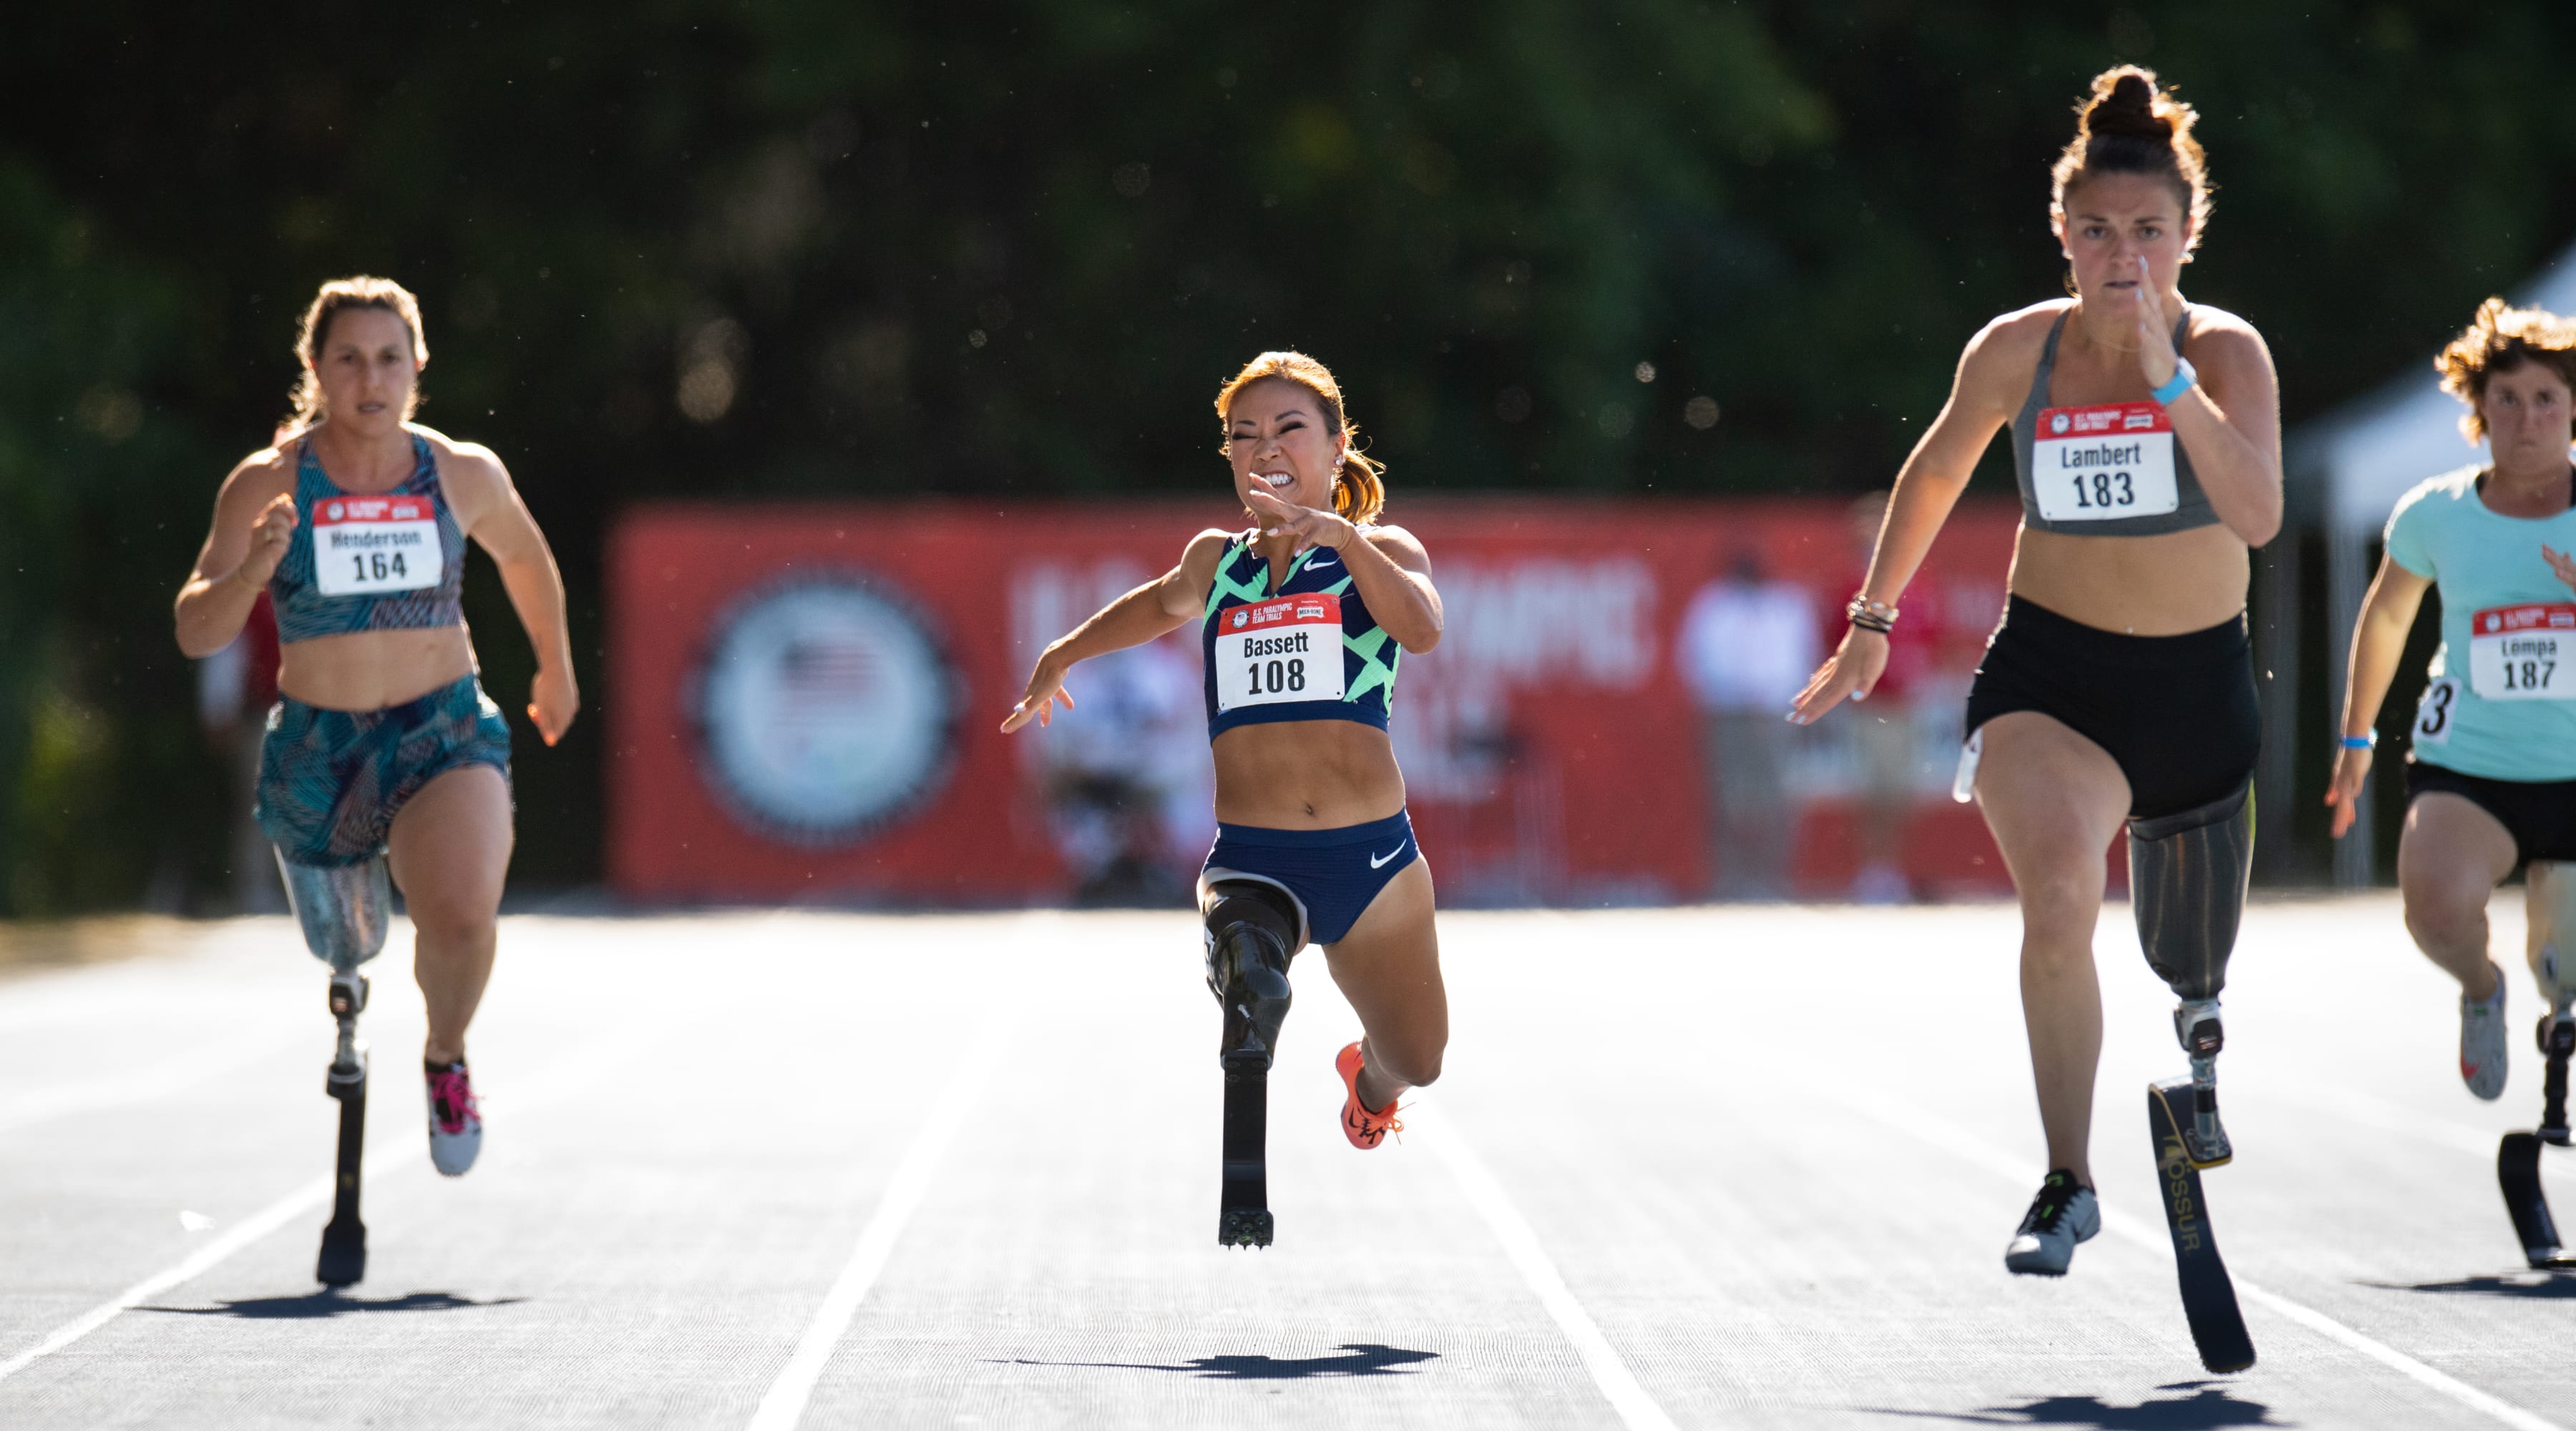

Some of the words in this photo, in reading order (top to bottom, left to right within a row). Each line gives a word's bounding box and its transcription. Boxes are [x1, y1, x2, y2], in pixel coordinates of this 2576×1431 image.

[2062, 441, 2142, 469] Lambert
[2073, 472, 2135, 508] 183
[331, 530, 422, 550] Henderson
[353, 552, 406, 582] 164
[1252, 614, 1265, 624] TEAM
[1266, 612, 1282, 622] TRIALS
[1263, 602, 1292, 615] PARALYMPIC
[1244, 632, 1309, 658] Bassett
[2502, 638, 2557, 659] Lompa
[1249, 658, 1305, 695] 108
[2504, 660, 2557, 690] 187
[2421, 683, 2452, 736] 3
